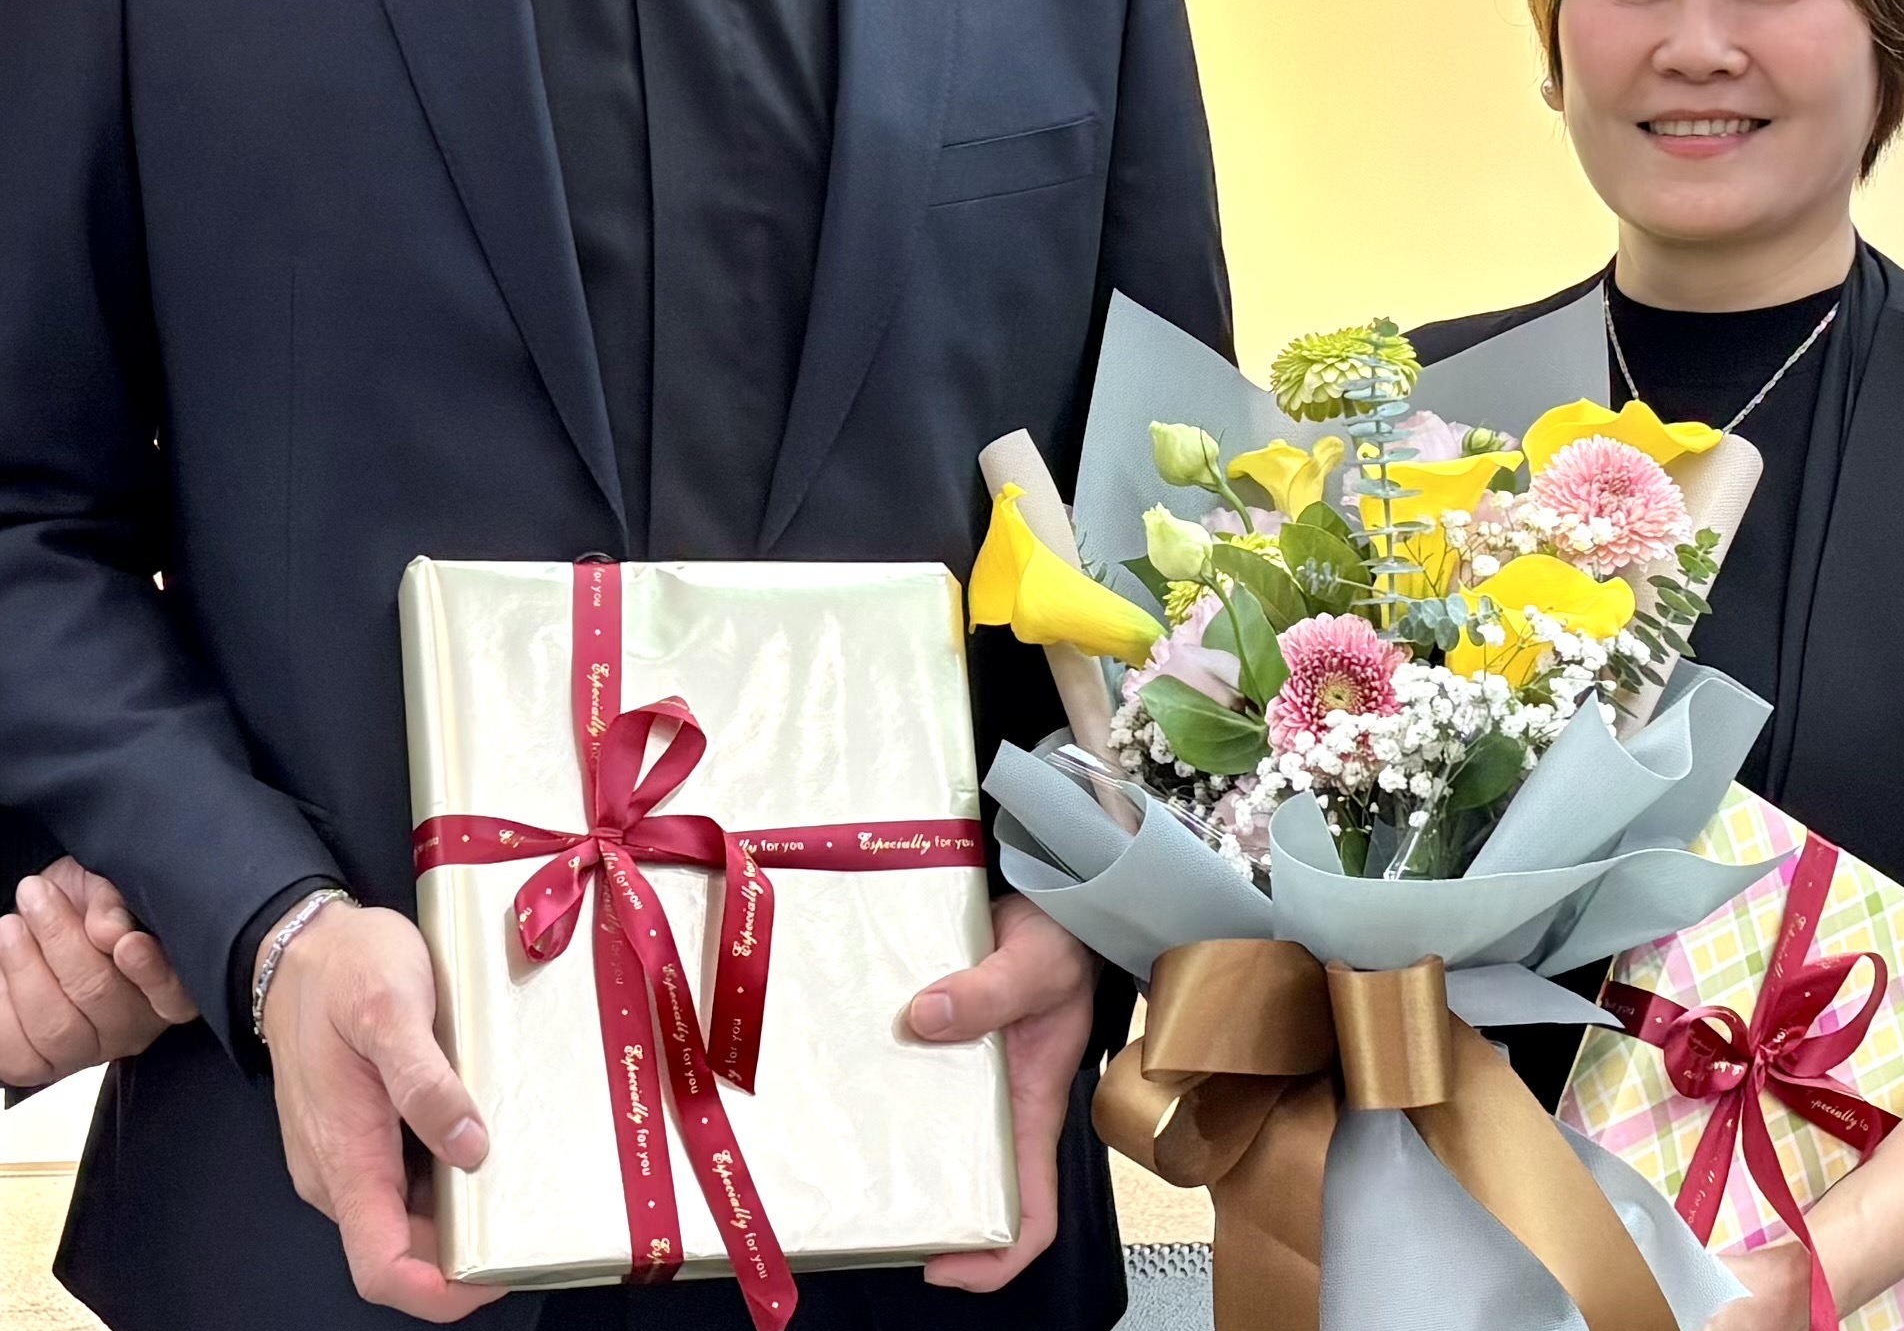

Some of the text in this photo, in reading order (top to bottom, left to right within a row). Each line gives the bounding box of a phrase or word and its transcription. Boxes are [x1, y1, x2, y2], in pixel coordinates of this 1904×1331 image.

[591, 585, 602, 607] you
[586, 663, 611, 737] Especially
[761, 839, 780, 852] for
[782, 840, 805, 854] you
[857, 831, 931, 856] Especially
[935, 835, 952, 849] for
[613, 871, 644, 911] for you
[732, 880, 764, 957] Especially
[662, 963, 699, 1096] Especially for you
[724, 1046, 738, 1065] for
[731, 1018, 742, 1042] you
[620, 1043, 652, 1177] Especially for you
[712, 1149, 769, 1280] Especially for you
